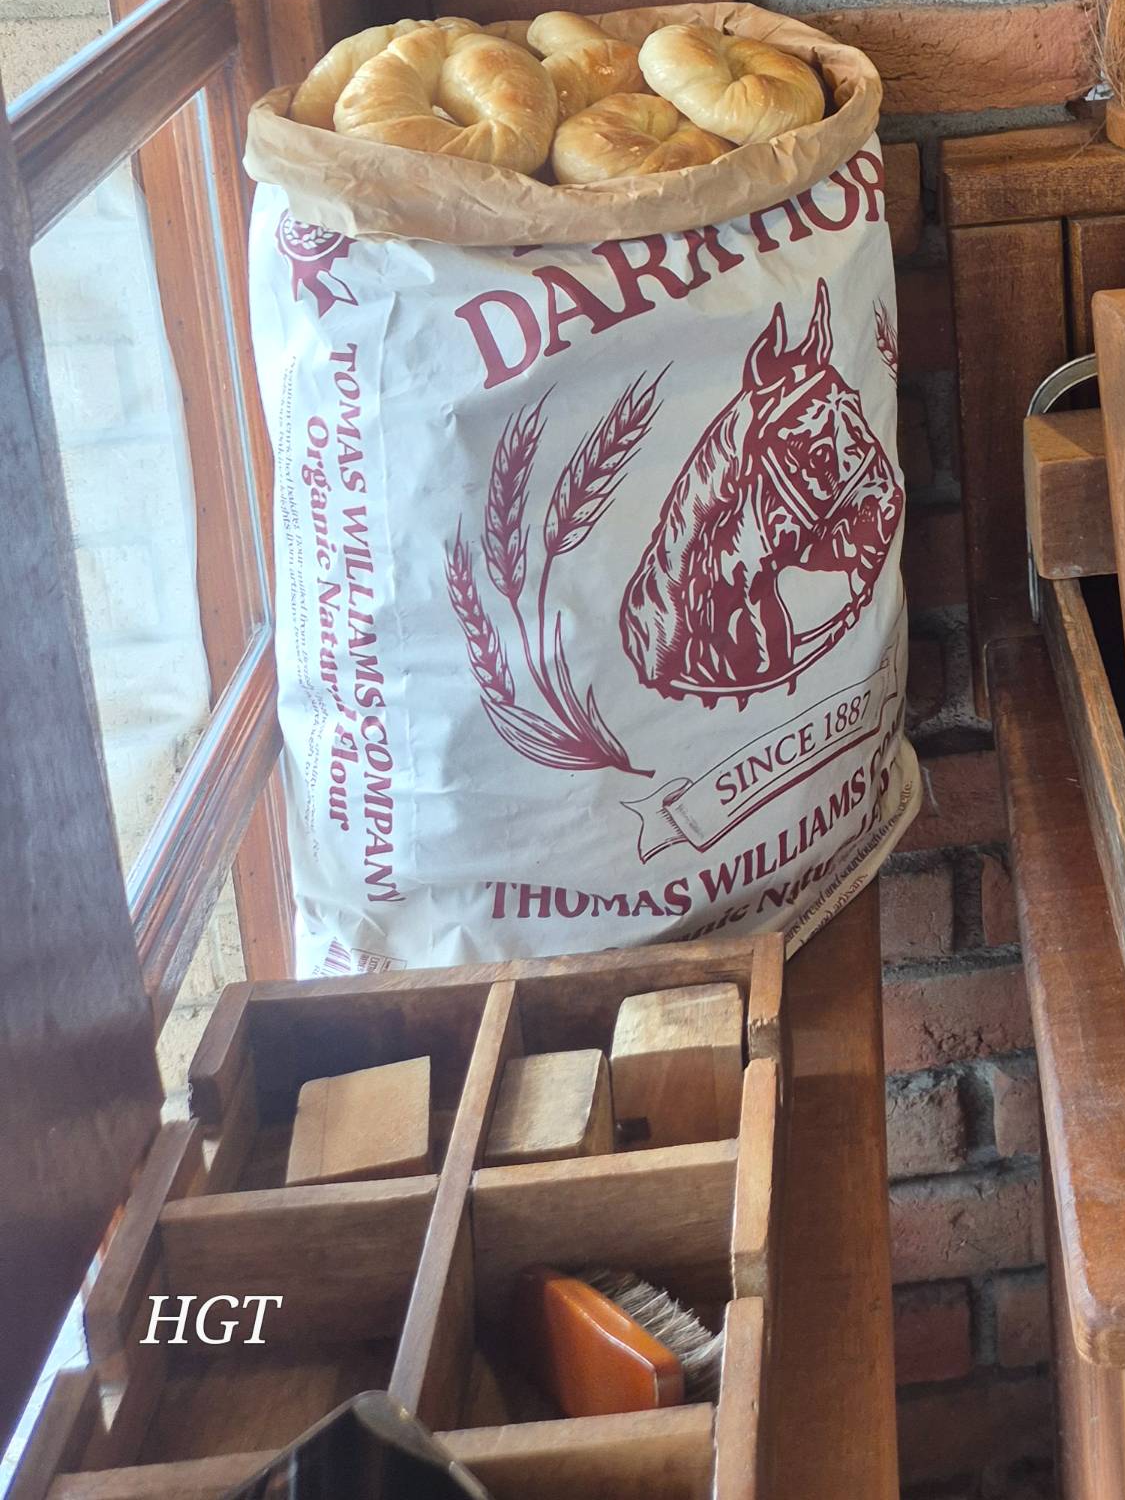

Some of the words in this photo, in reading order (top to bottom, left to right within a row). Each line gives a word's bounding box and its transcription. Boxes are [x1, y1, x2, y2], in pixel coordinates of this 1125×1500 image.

[301, 414, 338, 571] Organic
[329, 342, 369, 494] TOMAS
[341, 504, 386, 708] WILLIAMS
[359, 714, 406, 903] COMPANY
[714, 720, 817, 806] SINCE
[822, 689, 872, 741] 1887
[485, 877, 693, 919] THOMAS
[698, 767, 866, 902] WILLIAMS
